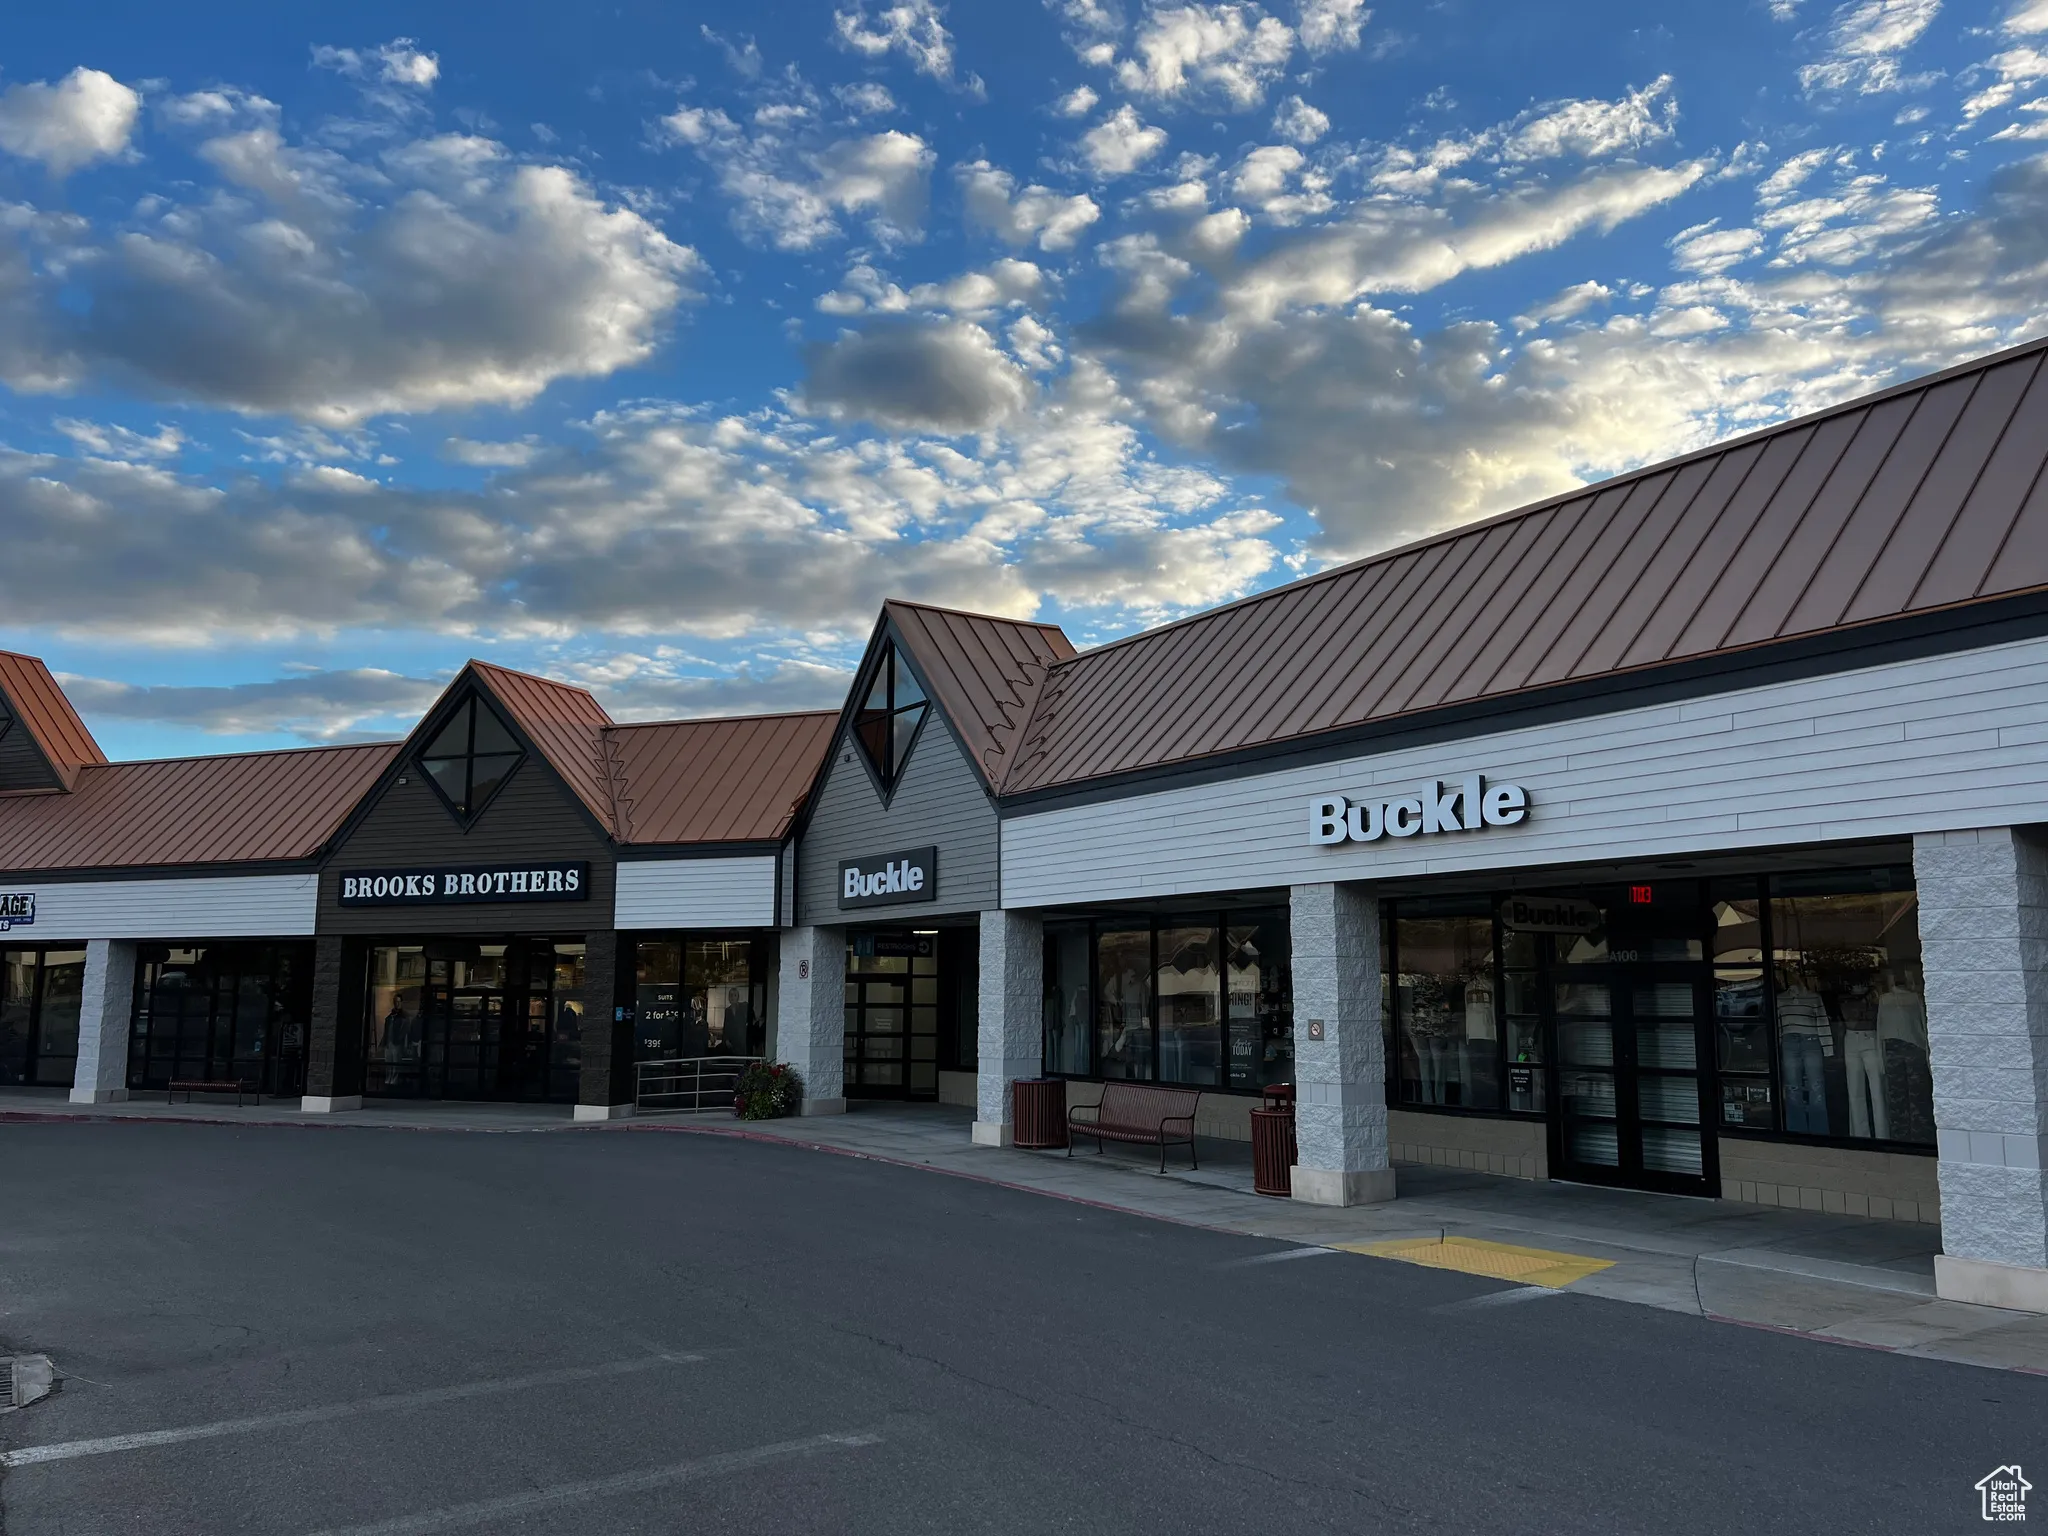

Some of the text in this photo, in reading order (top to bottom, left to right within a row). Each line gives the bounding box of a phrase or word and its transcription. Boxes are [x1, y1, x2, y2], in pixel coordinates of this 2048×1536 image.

[1309, 775, 1531, 846] Buckle
[343, 869, 579, 898] BROOKS BROTHERS
[844, 859, 924, 899] Buckle
[1513, 901, 1592, 927] Buckle
[1609, 950, 1638, 962] A100
[645, 1011, 651, 1020] 2
[653, 1011, 665, 1020] for
[1231, 1045, 1253, 1056] TODAY
